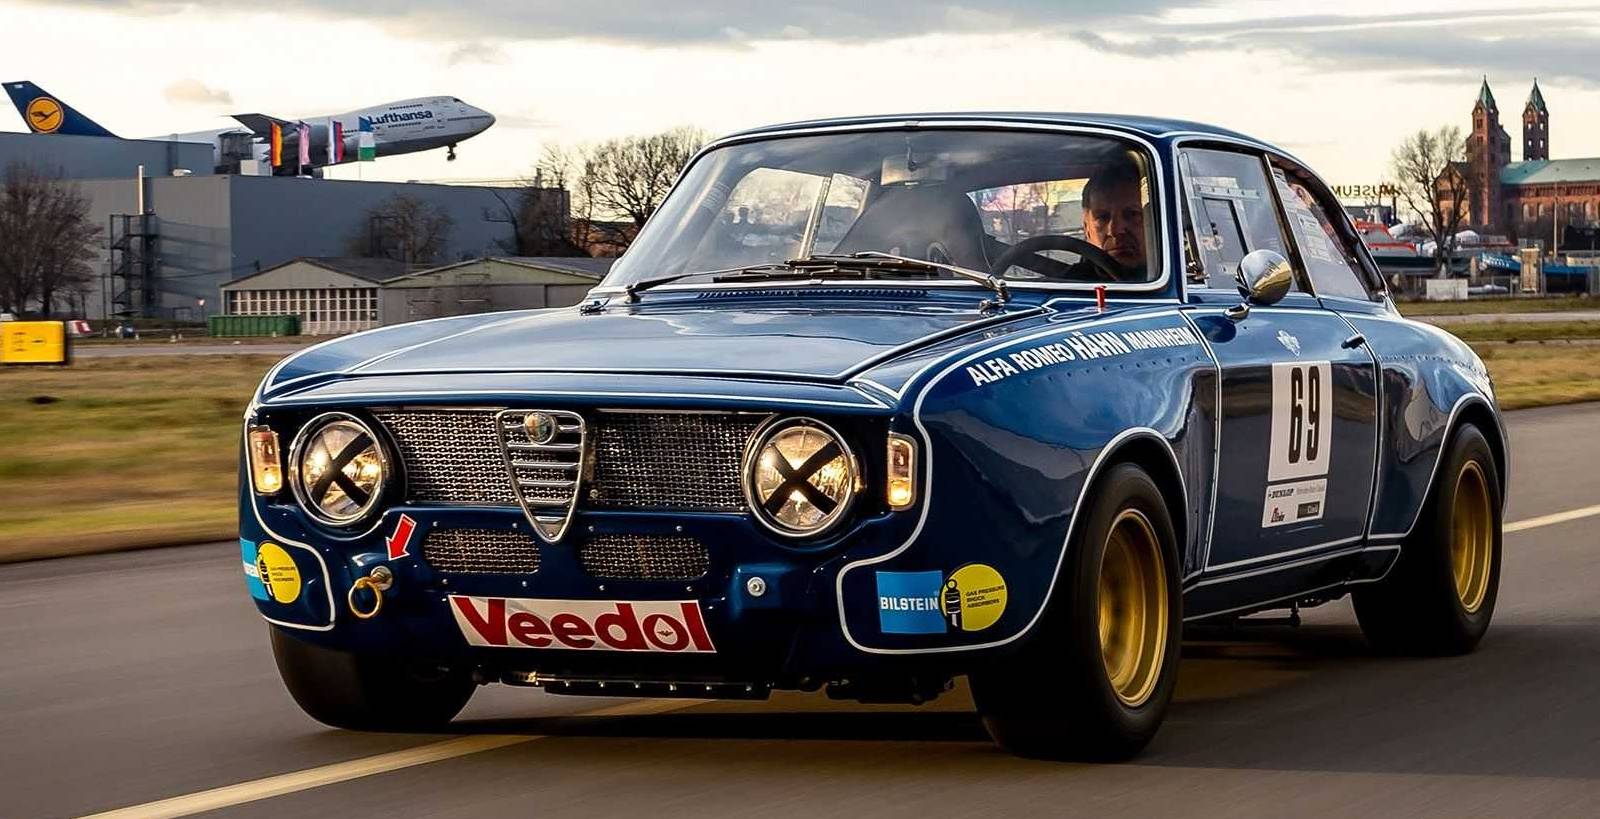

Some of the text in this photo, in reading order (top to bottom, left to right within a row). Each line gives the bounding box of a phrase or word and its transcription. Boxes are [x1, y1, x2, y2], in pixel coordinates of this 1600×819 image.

[368, 110, 433, 124] Lufthansa
[966, 326, 1200, 387] ALFA ROMEO HÄHN MANNHEIM
[1288, 366, 1320, 464] 69
[452, 596, 717, 652] Veedol
[880, 597, 939, 610] BILSTEIN
